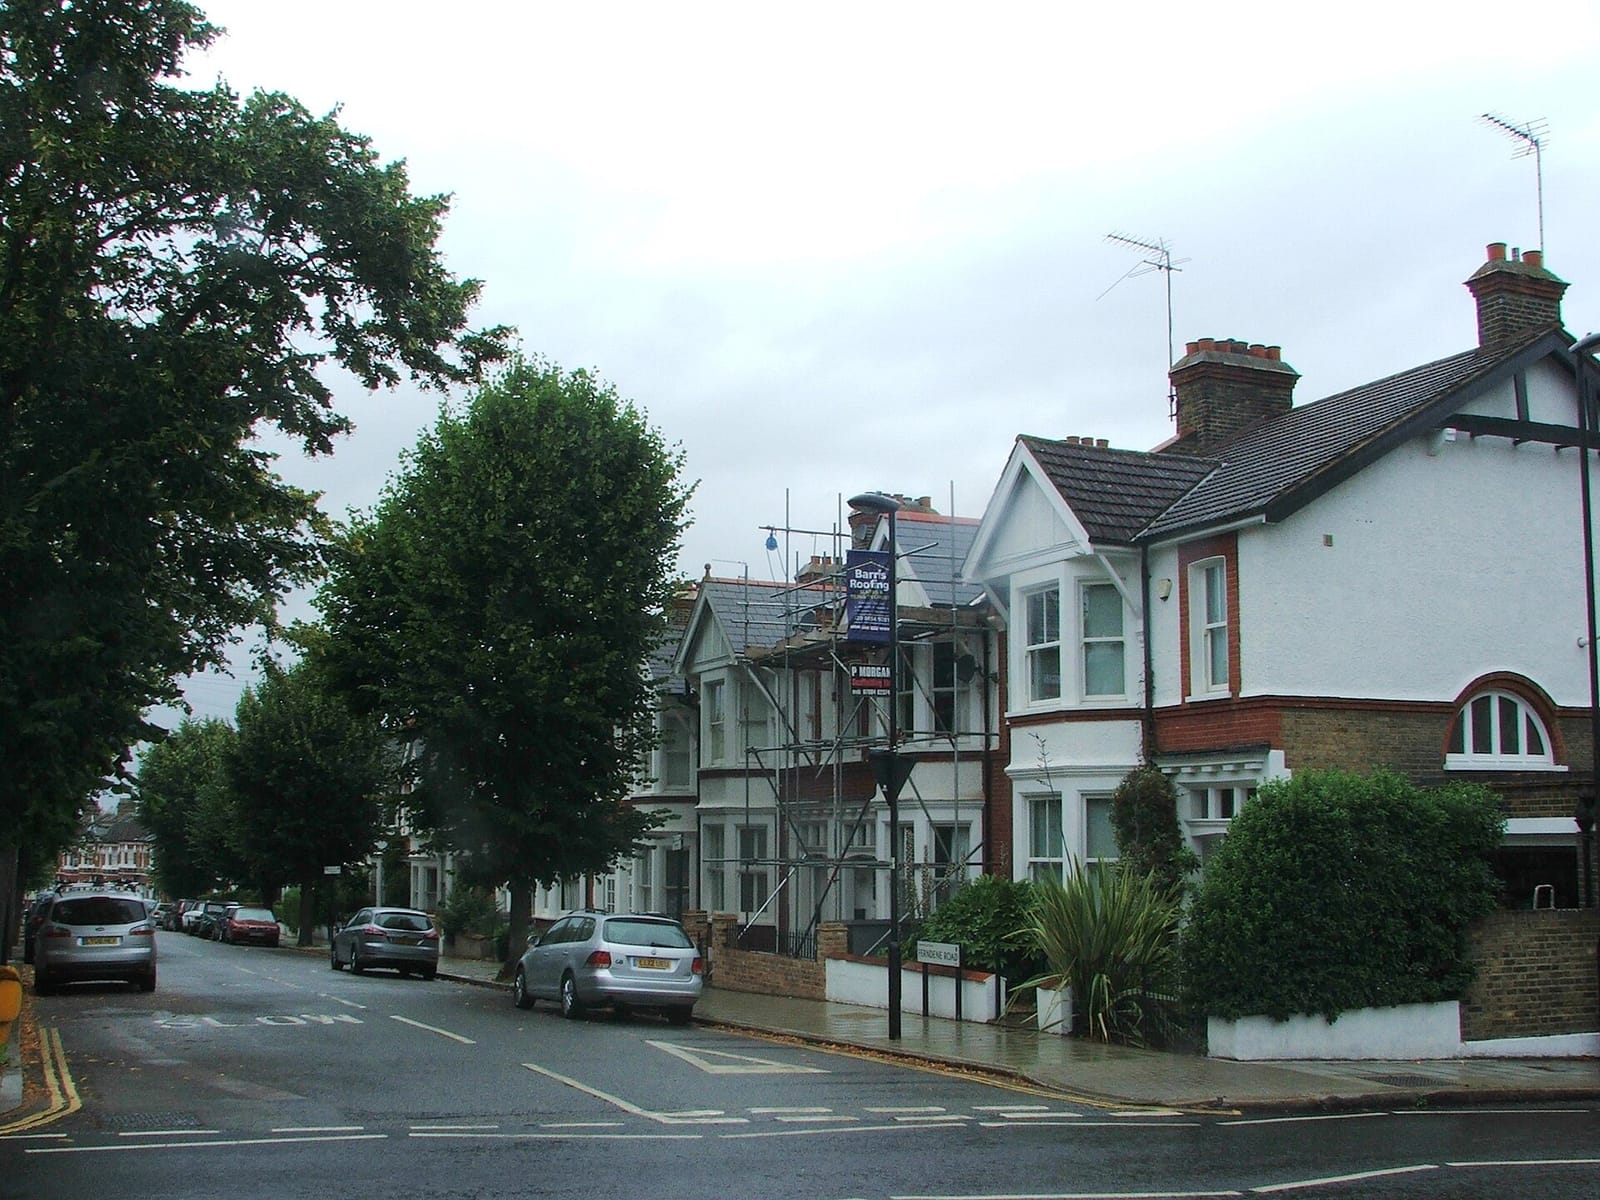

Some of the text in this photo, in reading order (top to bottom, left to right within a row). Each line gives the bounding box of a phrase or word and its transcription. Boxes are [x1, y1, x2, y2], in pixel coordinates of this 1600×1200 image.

[849, 579, 890, 592] Roofing
[851, 666, 858, 677] P
[944, 951, 959, 961] ROAD
[152, 1012, 365, 1029] SLOW
